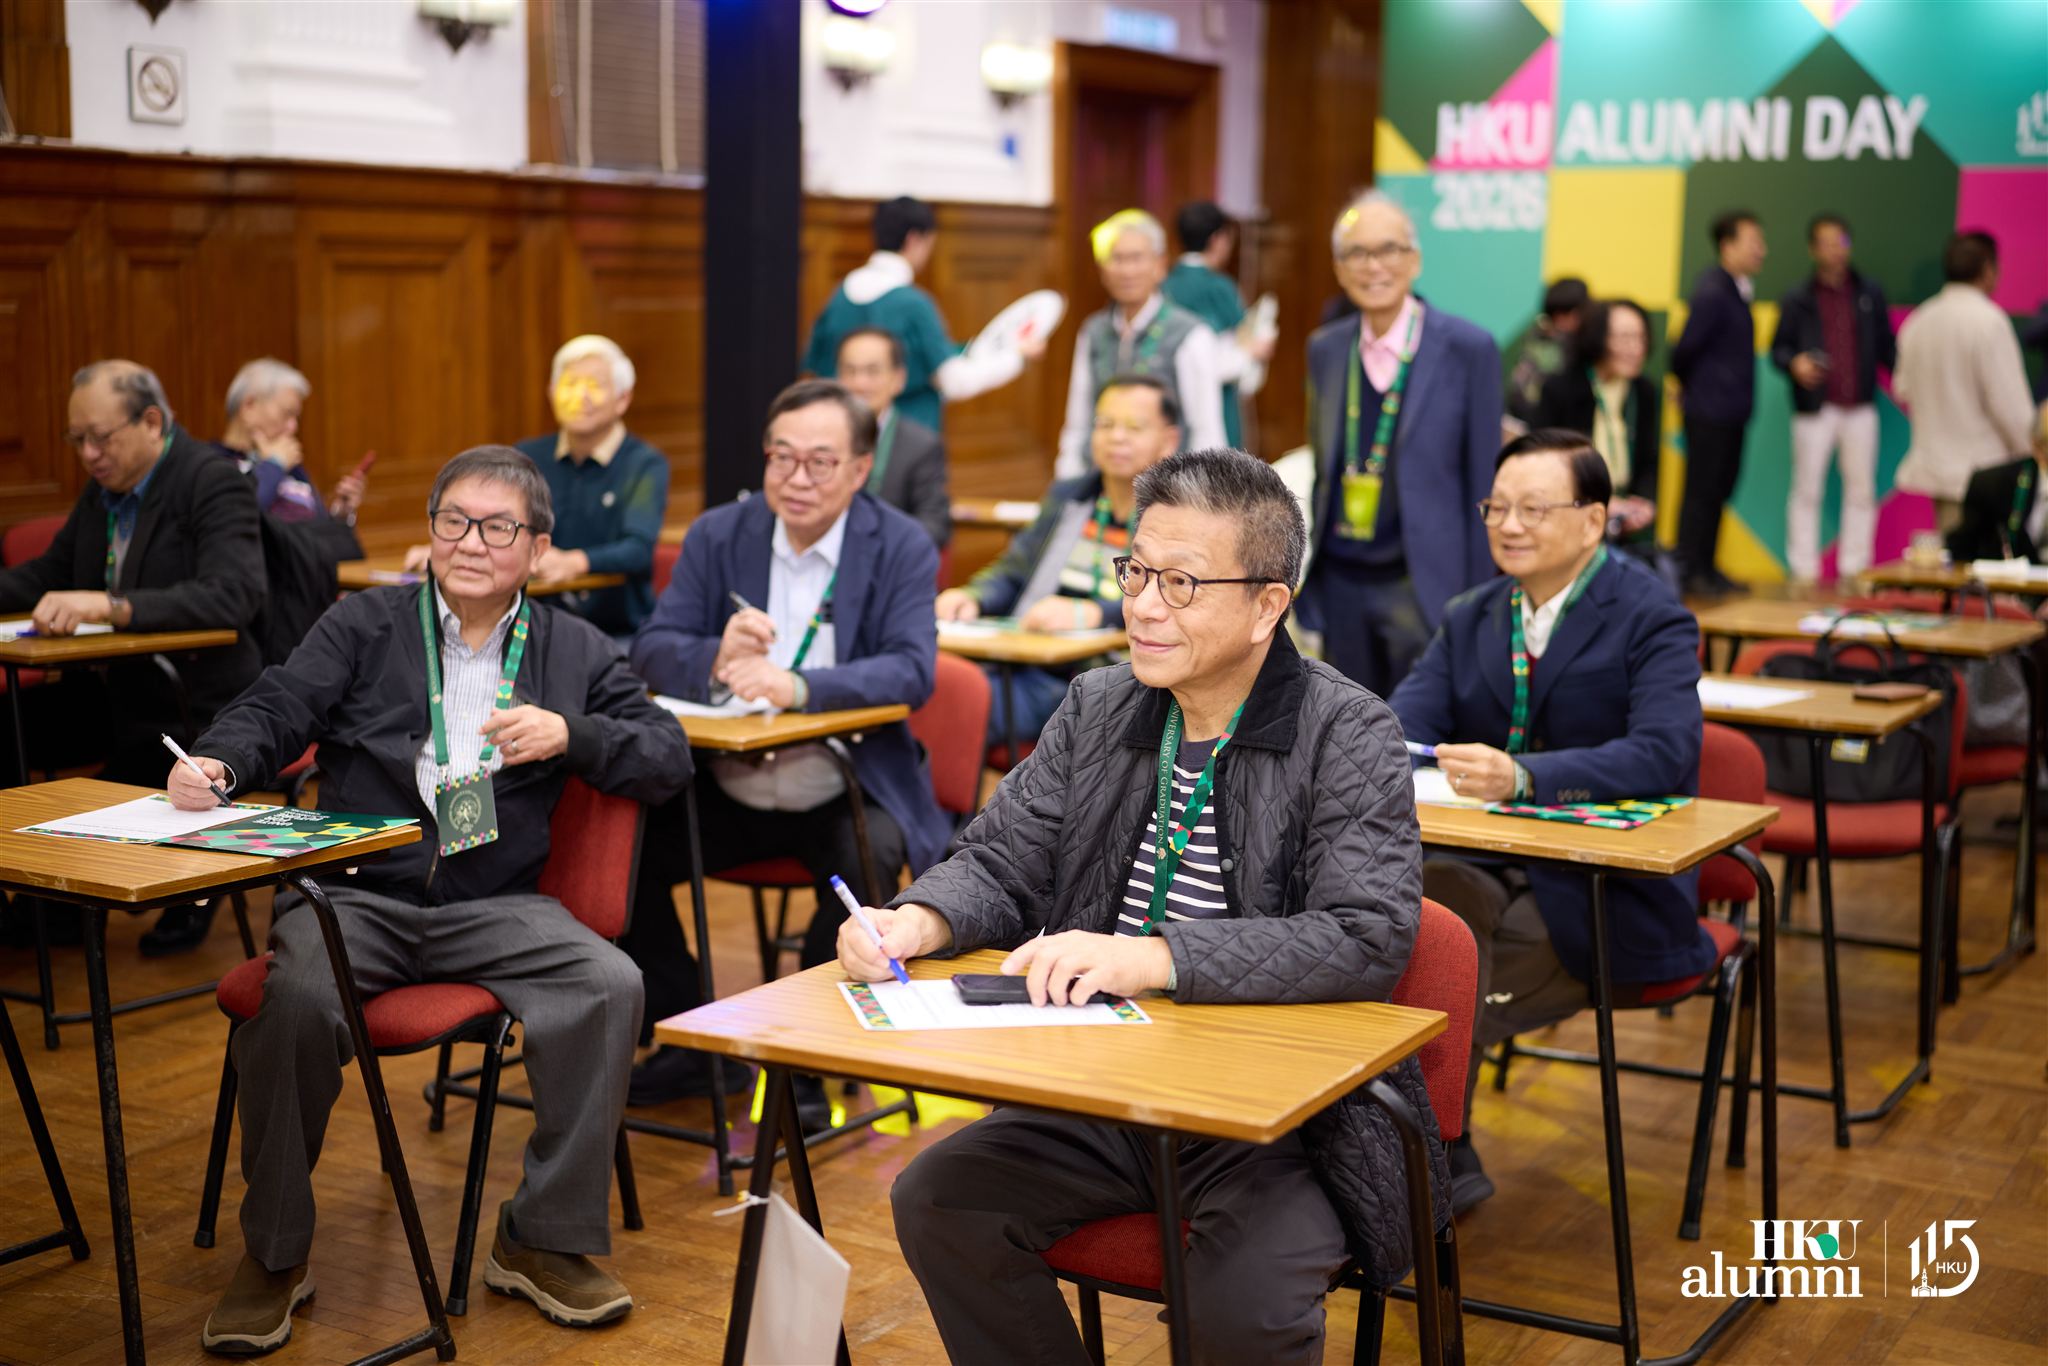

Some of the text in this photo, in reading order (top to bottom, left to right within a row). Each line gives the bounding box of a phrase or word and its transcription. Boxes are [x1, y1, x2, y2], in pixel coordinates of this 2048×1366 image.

[1436, 94, 1928, 162] HKU ALUMNI DAY
[1158, 704, 1181, 844] NNIVERSARY OF GRADUATION
